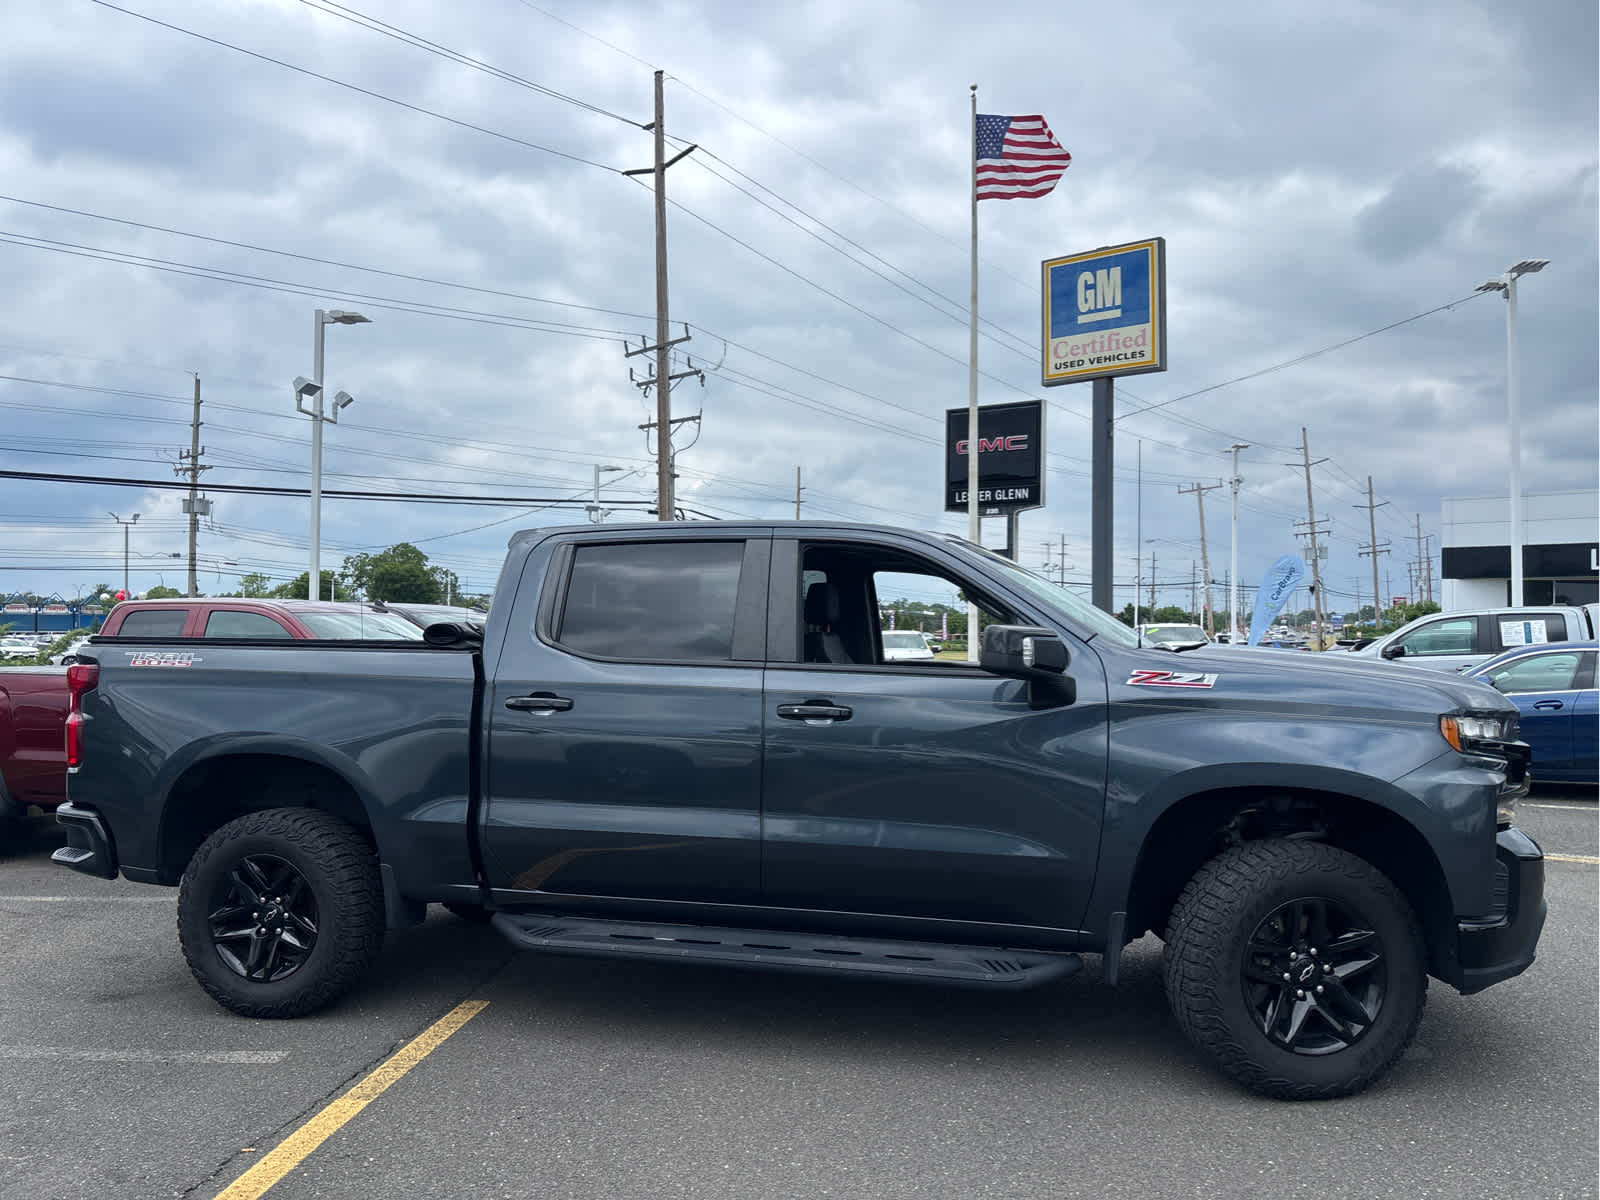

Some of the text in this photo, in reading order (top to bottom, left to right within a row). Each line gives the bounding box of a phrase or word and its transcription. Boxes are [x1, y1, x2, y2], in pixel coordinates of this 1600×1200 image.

[1077, 266, 1122, 313] GM
[1053, 328, 1148, 359] Certified
[1055, 350, 1145, 370] USED VEHICLES
[955, 488, 1029, 503] LEER GLENN
[130, 659, 193, 668] BOSS
[1126, 669, 1220, 689] Z71
